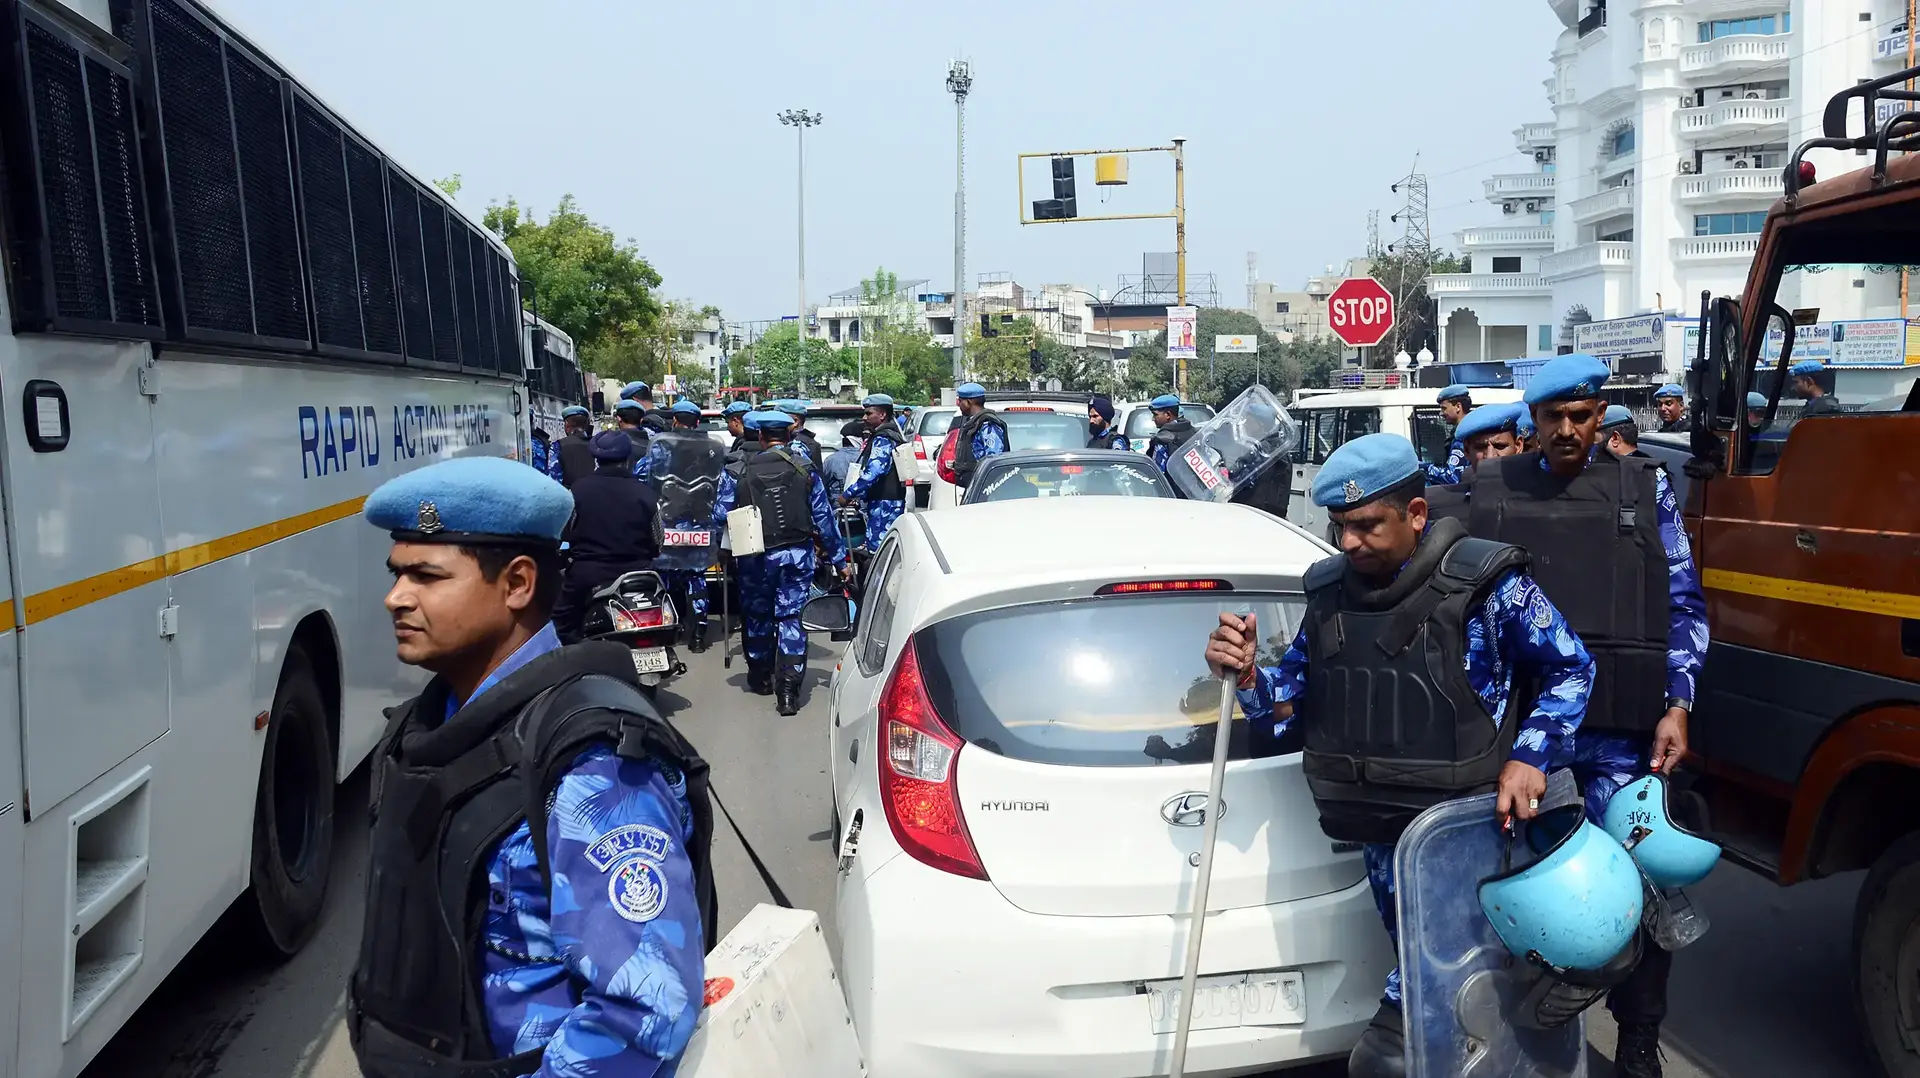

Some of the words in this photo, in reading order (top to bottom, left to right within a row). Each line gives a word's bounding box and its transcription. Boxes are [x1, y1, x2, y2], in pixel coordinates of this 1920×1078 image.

[1877, 102, 1905, 121] GUR
[1333, 297, 1388, 326] STOP
[1769, 330, 1783, 340] Dual
[1813, 327, 1830, 338] Scan
[1580, 342, 1593, 350] GURU
[1593, 340, 1609, 348] NANAK
[1609, 338, 1628, 347] MISSION
[1628, 336, 1653, 345] HOSPITAL
[299, 406, 380, 479] RAPID
[394, 404, 450, 462] ACTION
[453, 404, 491, 447] FORCE
[1185, 450, 1218, 488] POLICE
[635, 658, 662, 667] 2148
[981, 800, 1050, 811] HYUNDAI
